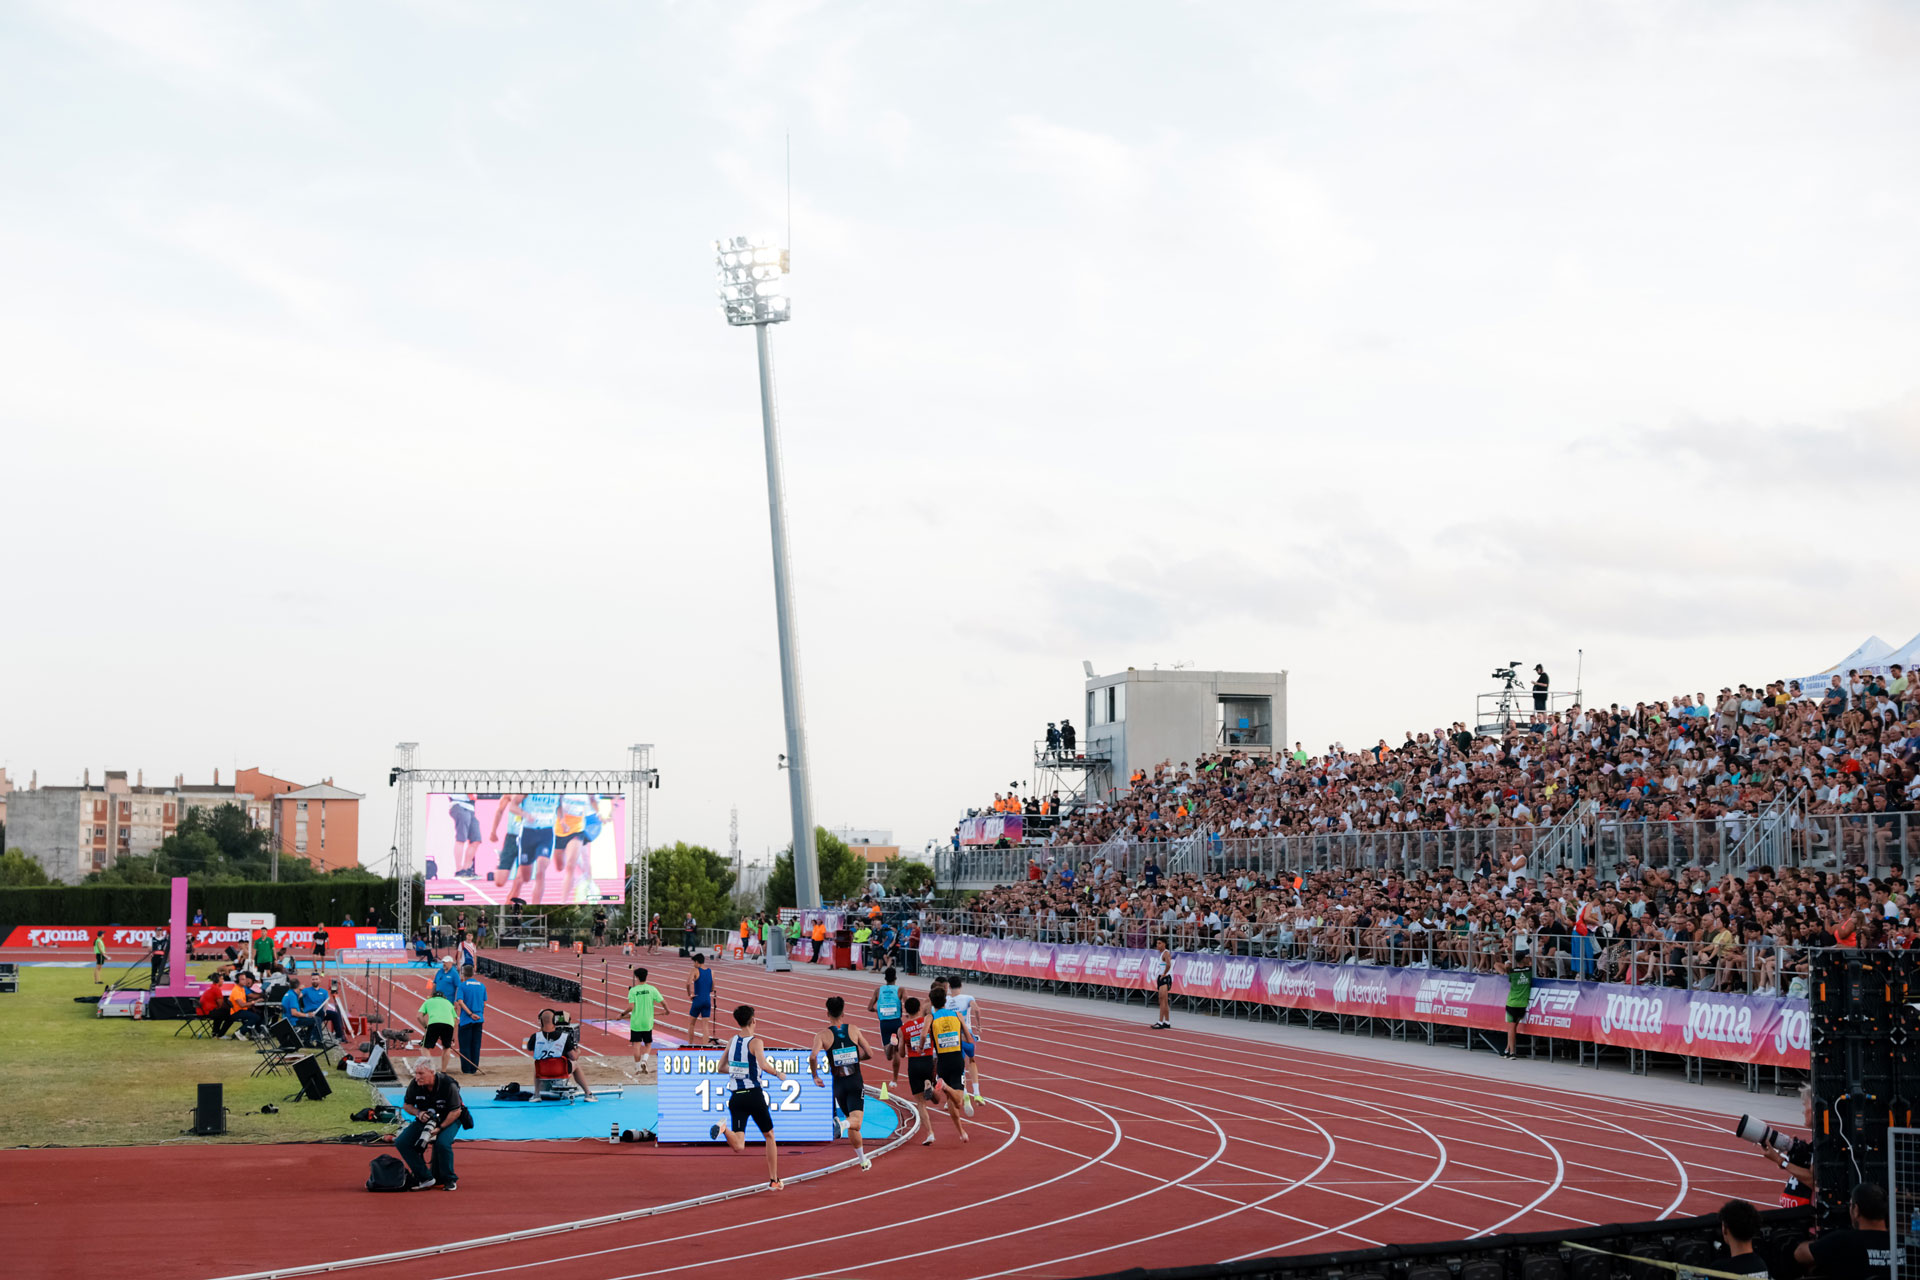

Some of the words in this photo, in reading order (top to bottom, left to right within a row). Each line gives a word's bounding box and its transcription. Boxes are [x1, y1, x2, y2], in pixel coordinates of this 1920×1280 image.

[40, 929, 89, 942] Joma
[286, 930, 316, 944] Jom
[1220, 962, 1256, 992] Joma
[1432, 1004, 1468, 1018] ATLETISMO
[1528, 1013, 1572, 1029] ATLETISMO
[1601, 993, 1662, 1034] Joma
[1683, 1001, 1752, 1045] Joma
[1775, 1008, 1811, 1055] Jo
[663, 1055, 691, 1074] 800
[698, 1056, 719, 1074] Ho
[695, 1079, 801, 1111] 1:.2
